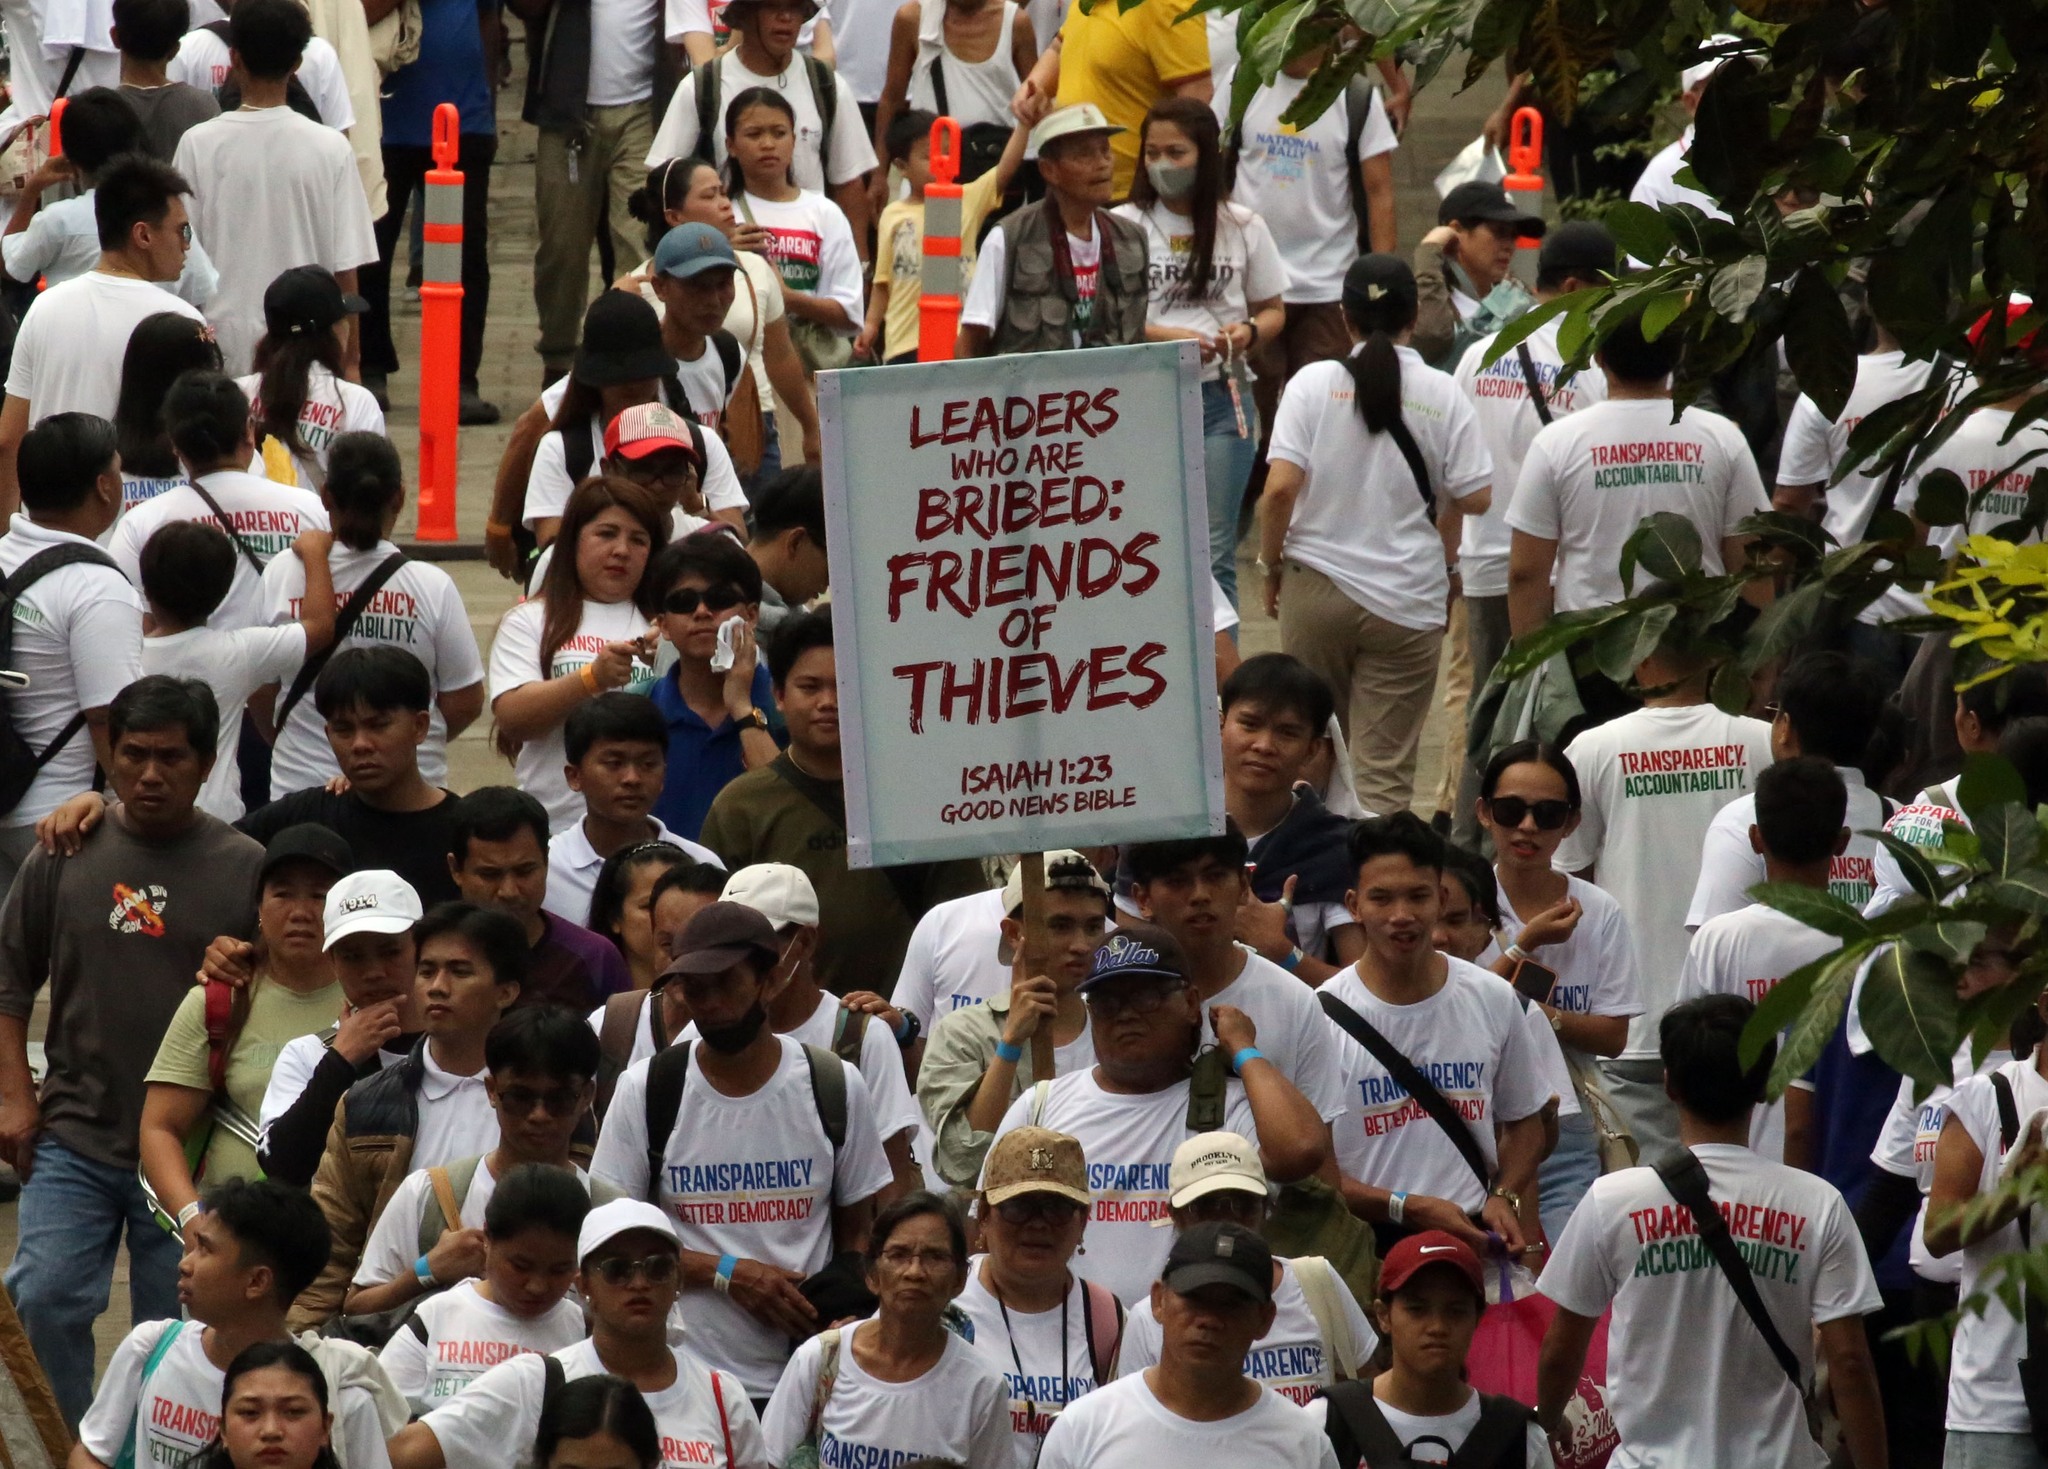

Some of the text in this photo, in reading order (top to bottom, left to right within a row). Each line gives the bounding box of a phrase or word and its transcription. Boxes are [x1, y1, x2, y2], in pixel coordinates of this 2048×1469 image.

[910, 388, 1119, 449] LEADERS
[952, 442, 1083, 480] WHO ARE
[1591, 442, 1705, 466] TRANSPARENCY.
[1594, 463, 1705, 489] ACCOUNTABILITY.
[915, 476, 1126, 542] BRIBED:
[887, 531, 1161, 622] FRIENDS
[998, 604, 1057, 650] OF
[893, 642, 1168, 734] THIEVES
[961, 755, 1113, 795] ISAIAH 1:23
[1619, 744, 1746, 775] TRANSPARENCY.
[1625, 768, 1746, 798] ACCOUNTABILITY.
[941, 787, 1136, 824] GOOD NEWS BIBLE
[339, 894, 378, 916] 1914
[1094, 940, 1159, 969] Dallas
[668, 1158, 812, 1193] TRANSPARENCY
[1190, 1151, 1241, 1169] BROOKLYN
[675, 1197, 814, 1225] BETTER DEMOCRACY
[1097, 1200, 1170, 1222] DEMOCRA
